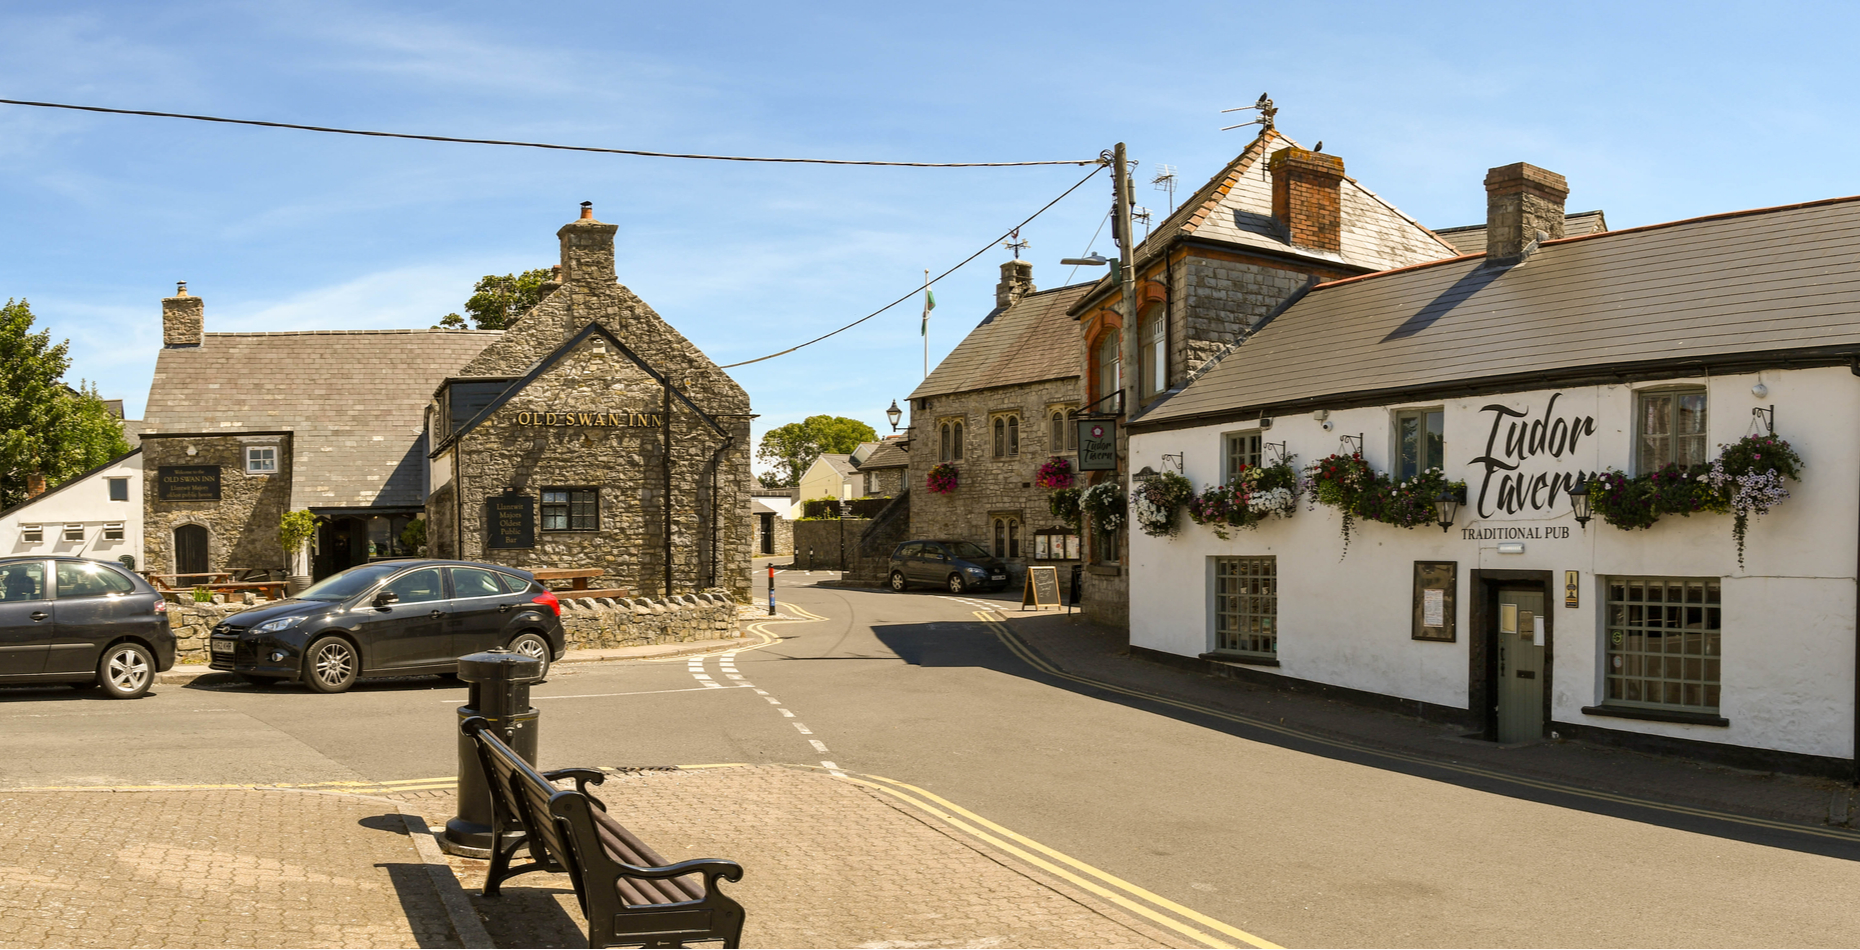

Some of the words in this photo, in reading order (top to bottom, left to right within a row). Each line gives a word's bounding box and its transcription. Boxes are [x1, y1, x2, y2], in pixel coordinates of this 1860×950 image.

[517, 411, 557, 426] OLD
[566, 412, 619, 427] SWAN
[629, 413, 662, 427] INN
[1478, 392, 1598, 461] Tudor
[1083, 438, 1112, 451] Tudor
[1082, 449, 1113, 463] Tavern
[1466, 456, 1598, 519] Taver
[499, 519, 522, 527] Oldest
[500, 527, 522, 535] Public
[1461, 527, 1543, 540] TRADITIONAL
[1545, 526, 1570, 539] PUB
